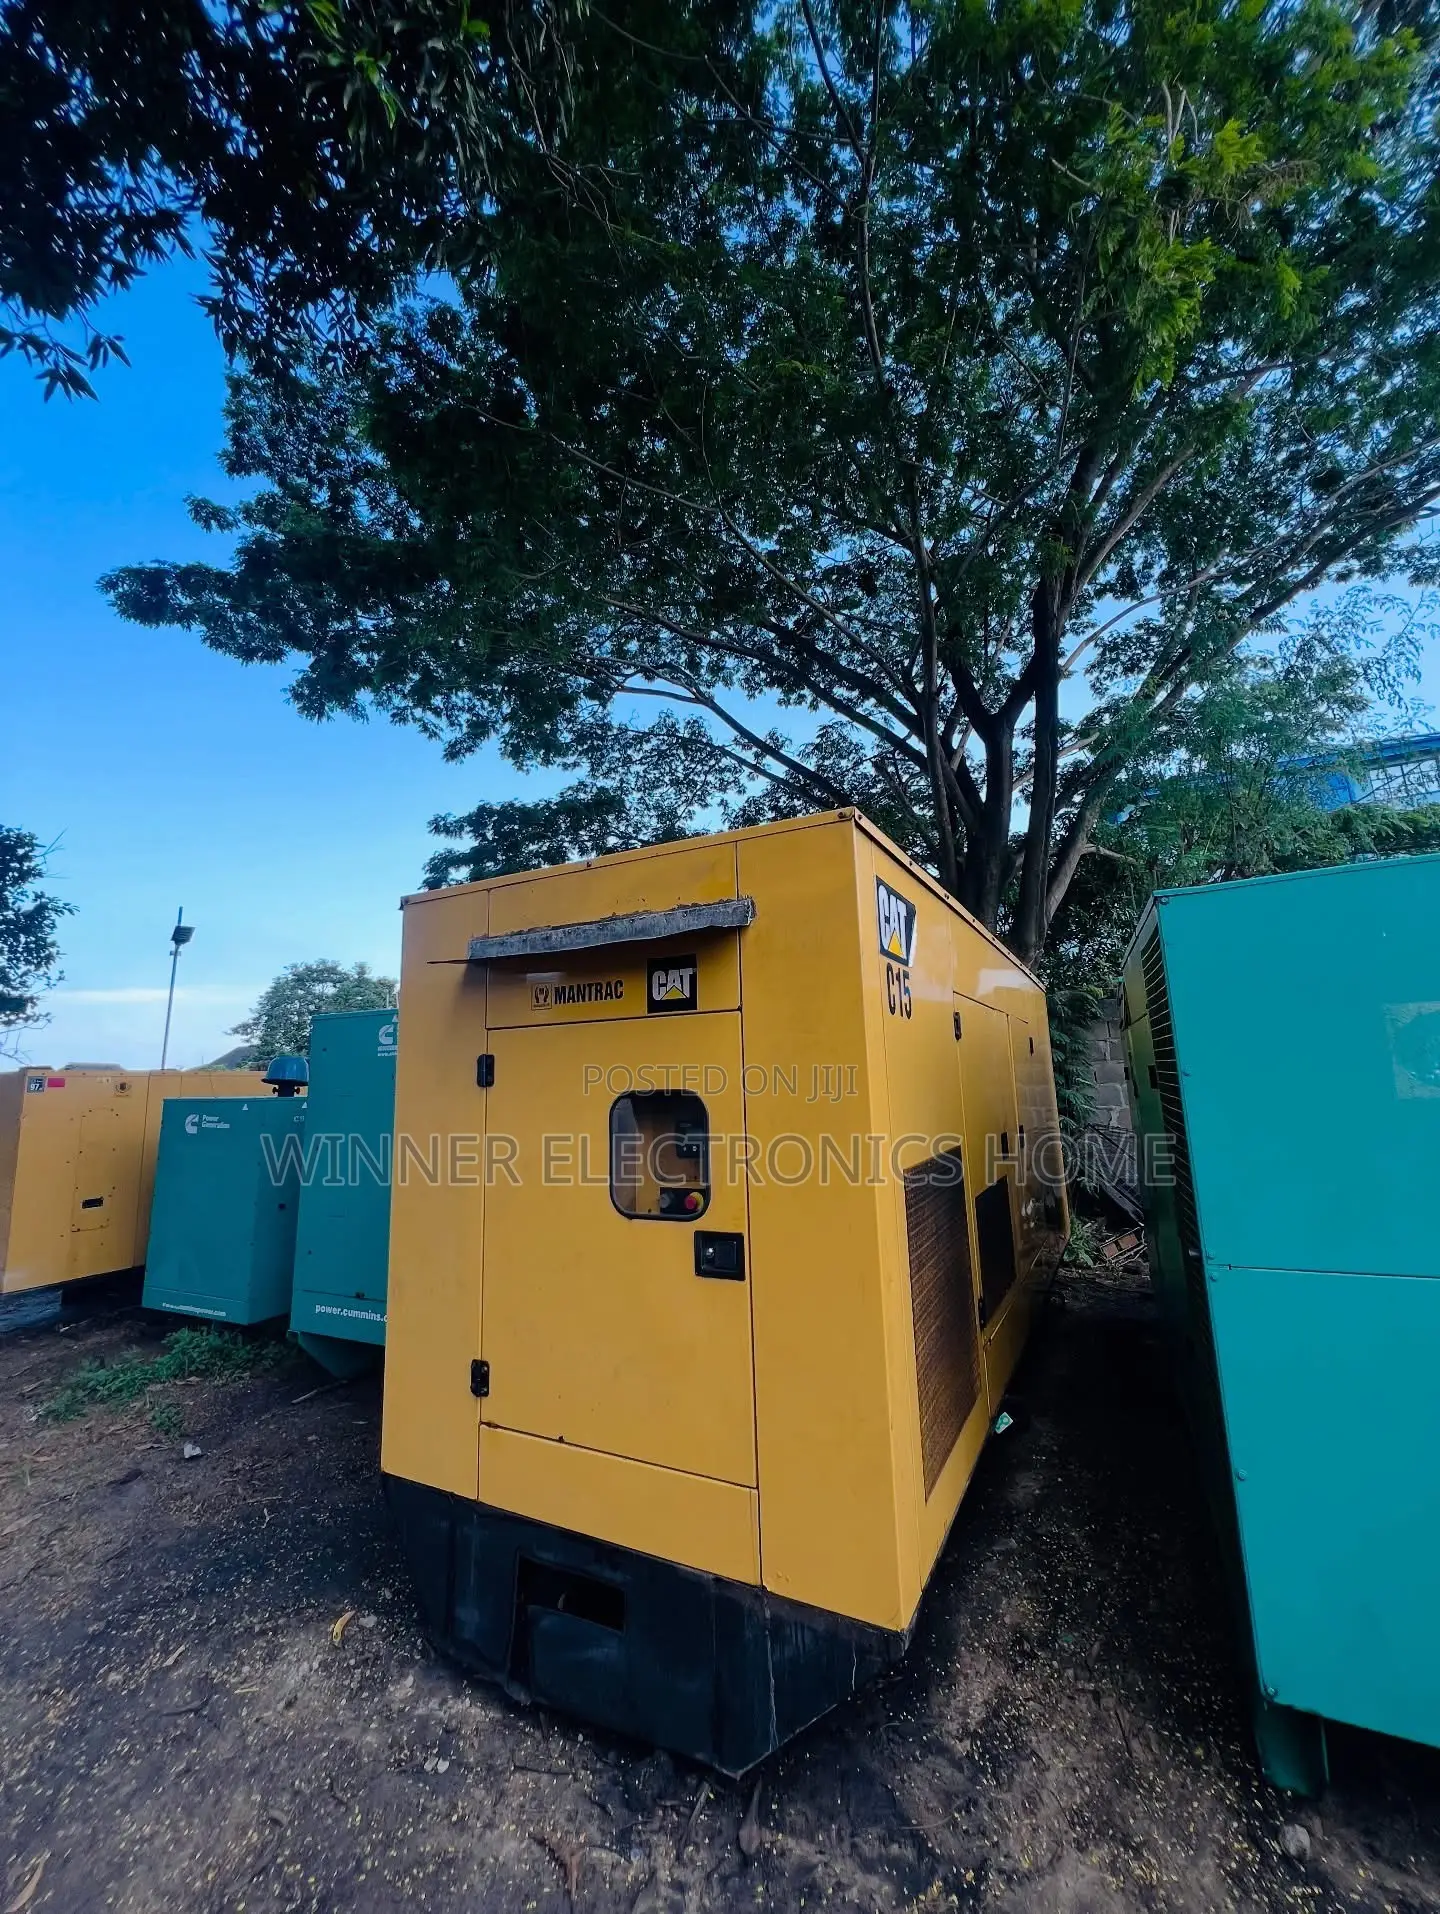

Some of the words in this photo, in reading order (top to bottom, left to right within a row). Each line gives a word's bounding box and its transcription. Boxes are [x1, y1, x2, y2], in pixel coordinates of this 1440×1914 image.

[878, 884, 908, 960] CAT
[554, 980, 624, 1005] MANTRAC
[652, 968, 693, 1001] CAT
[886, 962, 912, 1020] C15
[30, 1083, 40, 1091] 97
